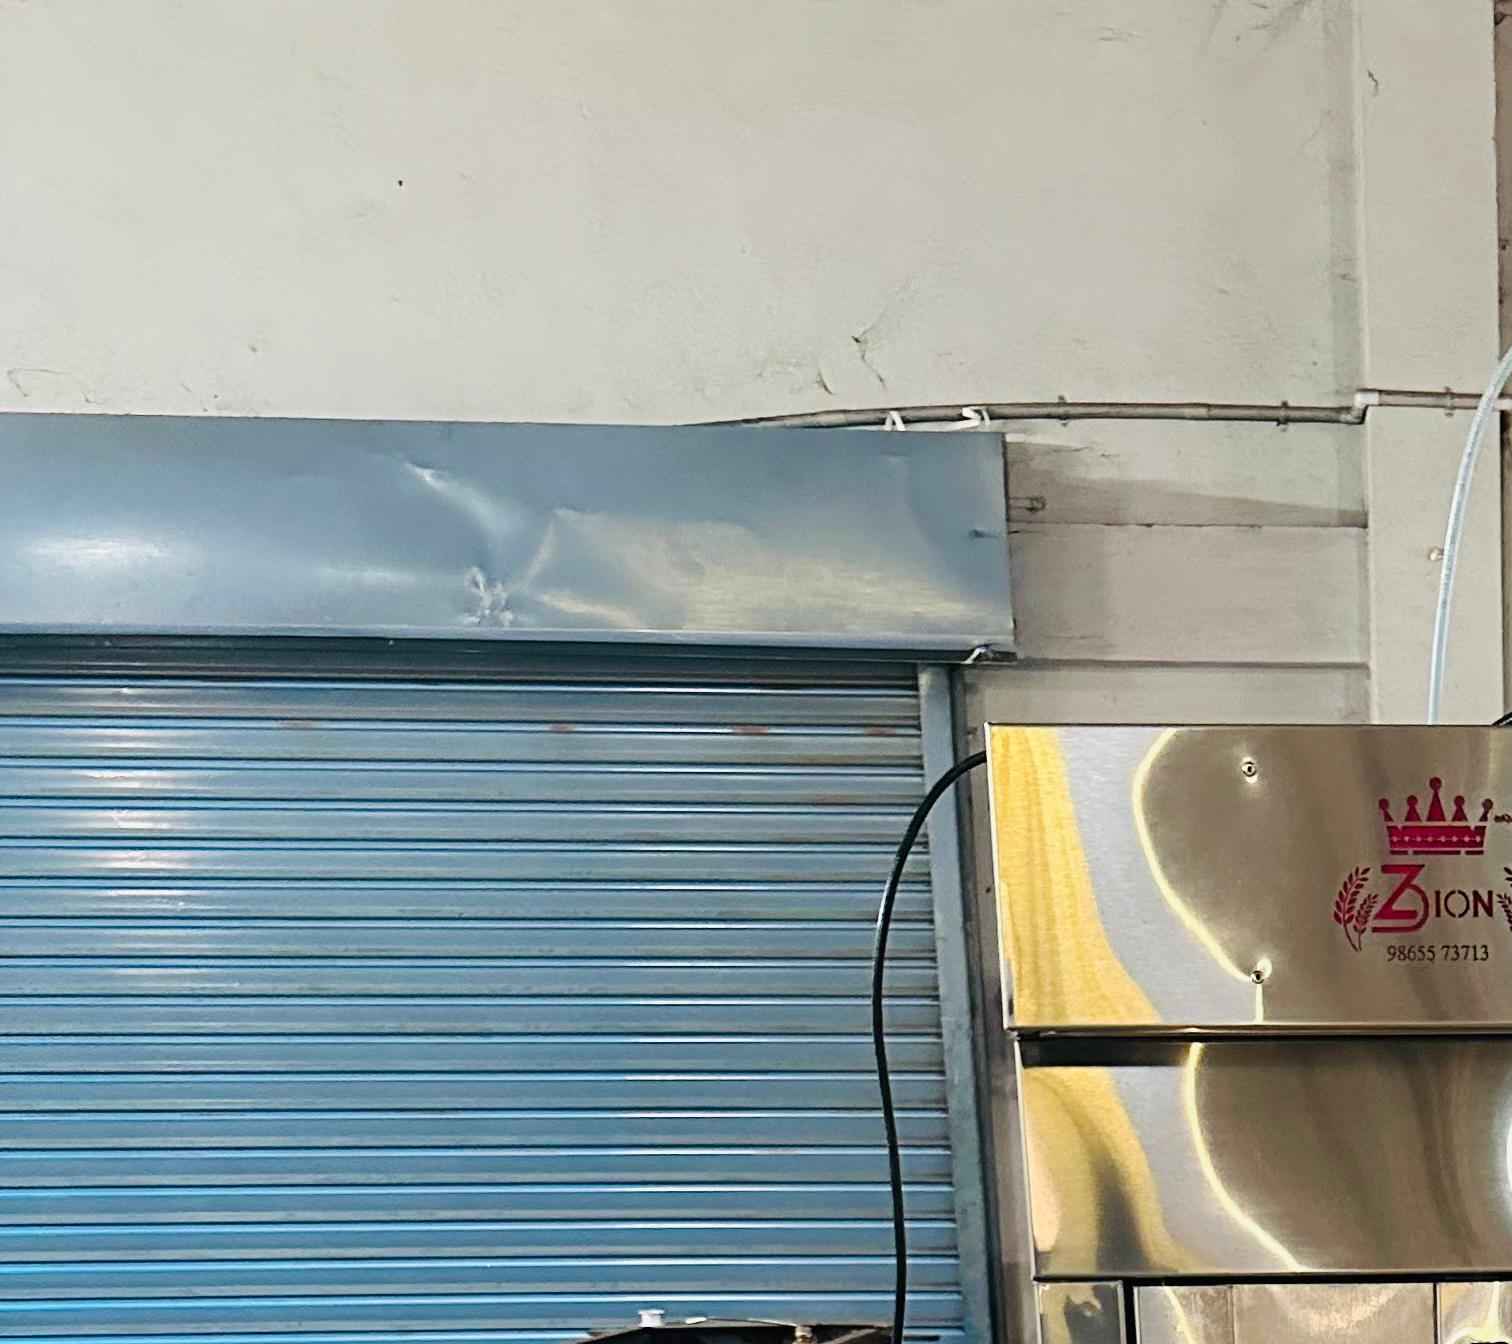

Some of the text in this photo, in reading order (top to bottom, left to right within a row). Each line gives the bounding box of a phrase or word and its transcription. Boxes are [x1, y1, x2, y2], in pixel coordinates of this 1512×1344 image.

[1372, 864, 1495, 934] ZION
[1387, 944, 1490, 963] 98655 73713
